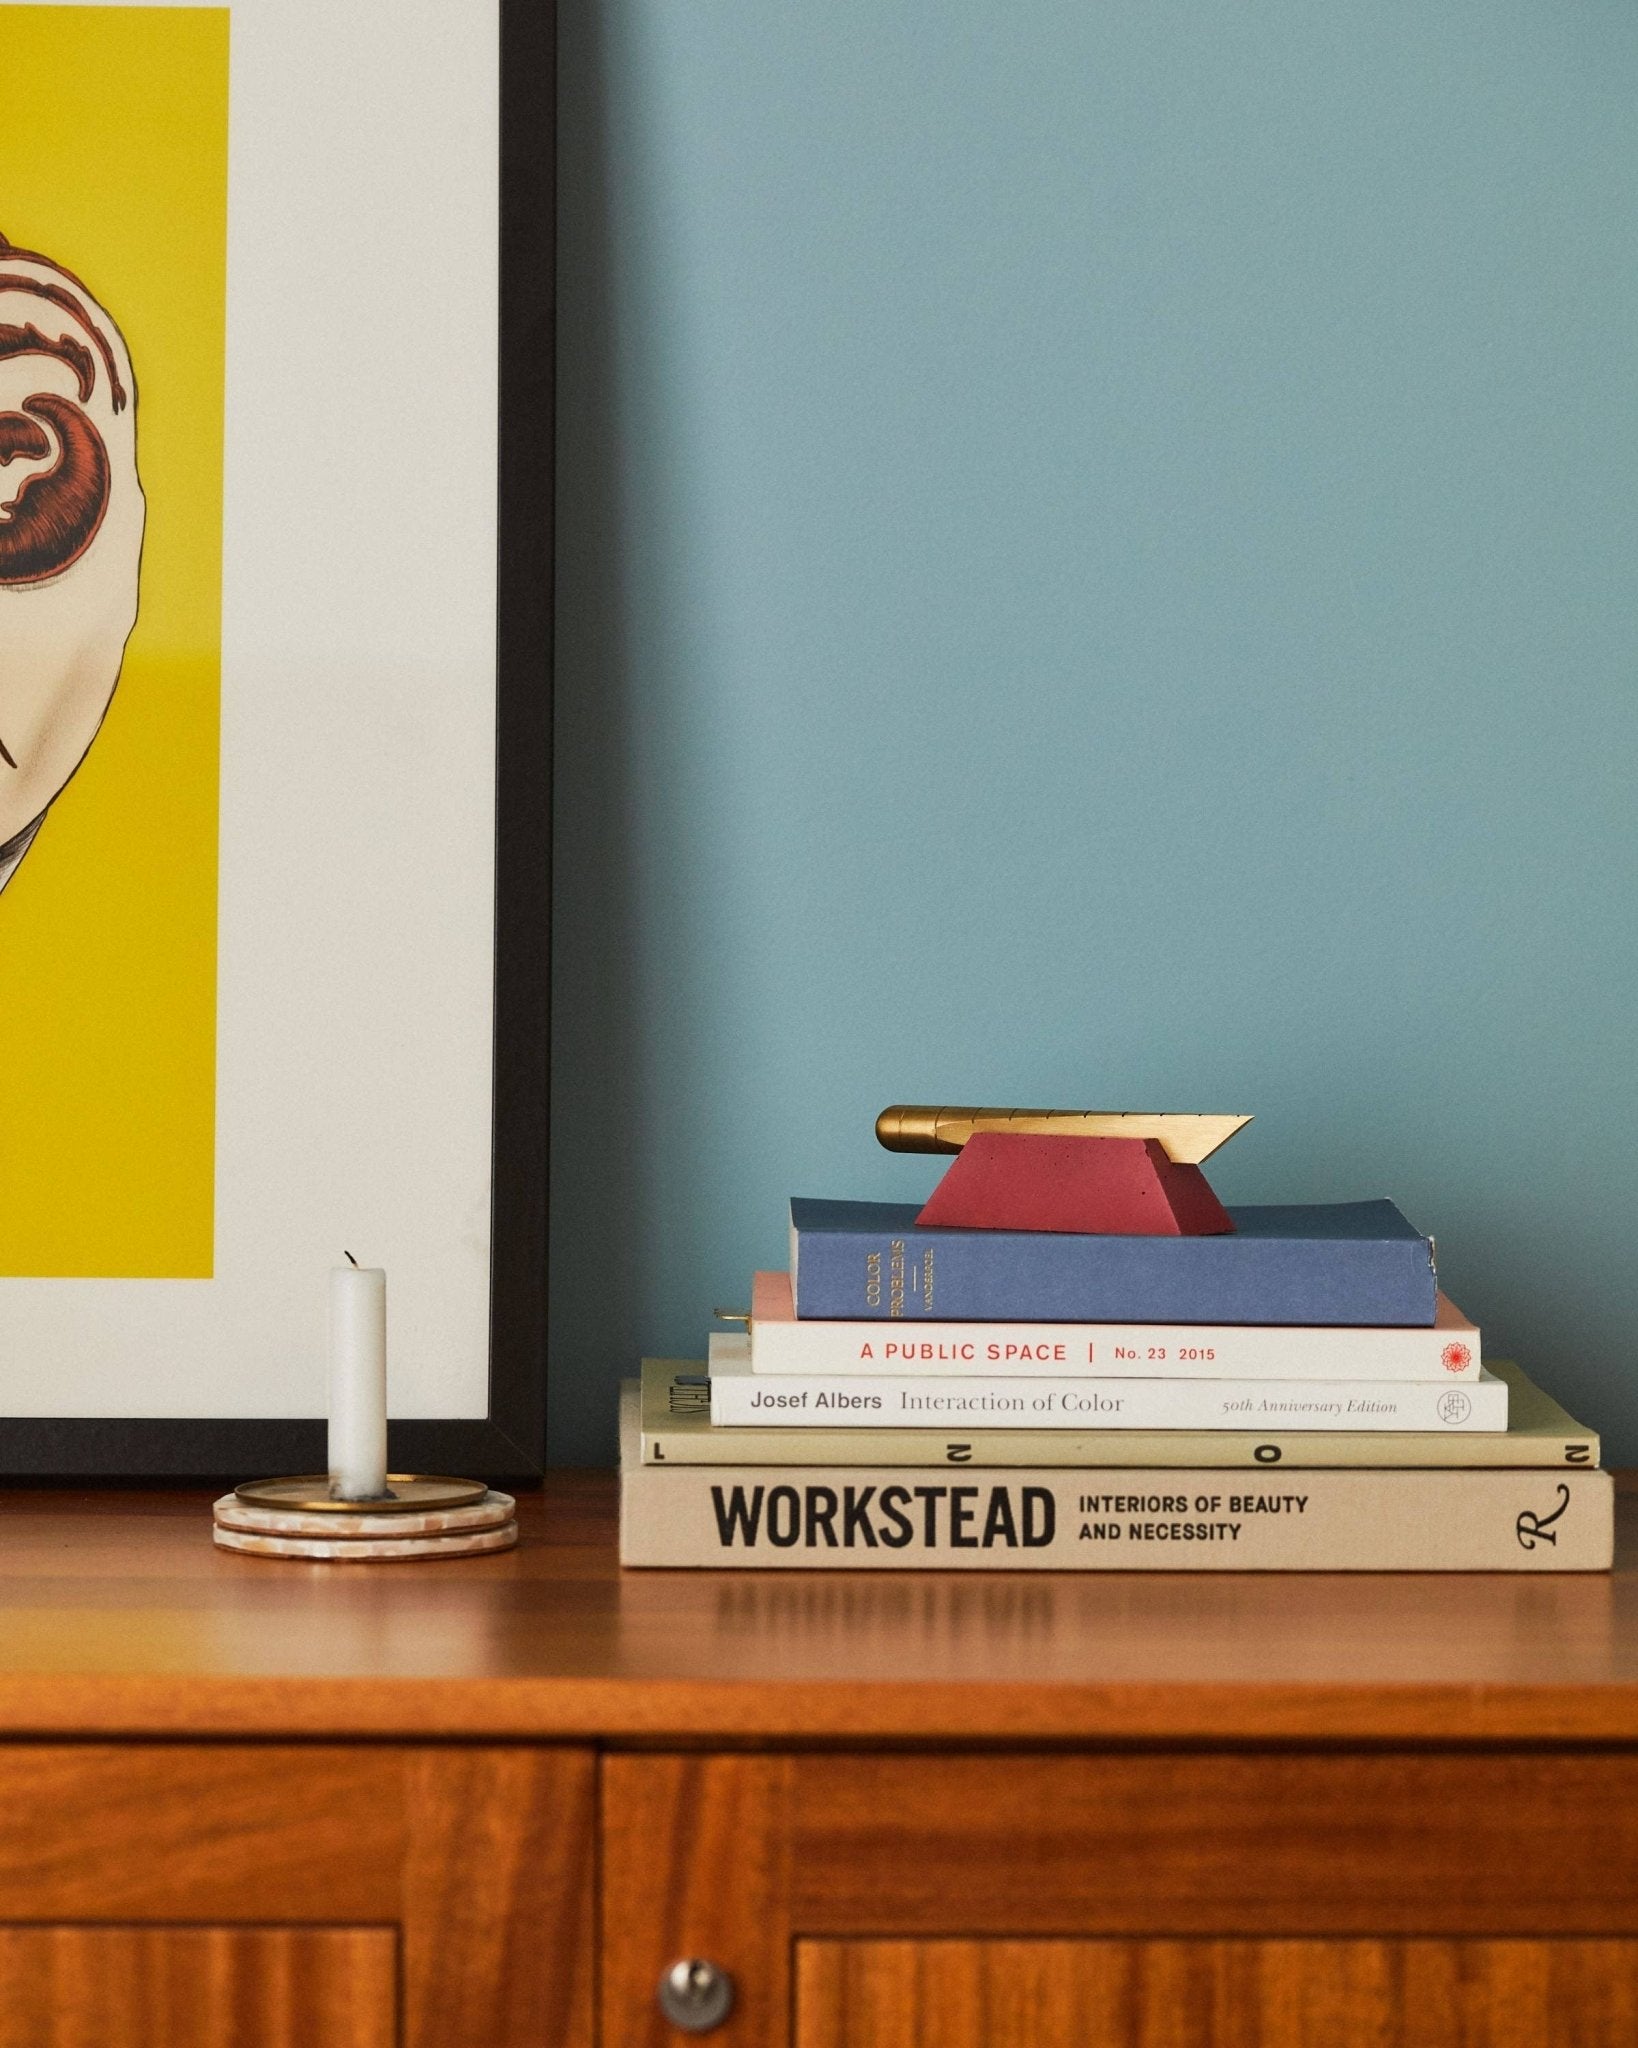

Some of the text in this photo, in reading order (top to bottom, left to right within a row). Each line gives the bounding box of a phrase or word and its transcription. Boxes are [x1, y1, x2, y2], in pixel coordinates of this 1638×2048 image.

[866, 1252, 880, 1306] COLOR
[890, 1240, 904, 1317] PROBLEMS
[860, 1343, 1066, 1361] A PUBLIC SPACE
[1115, 1347, 1216, 1360] No. 23 2015
[750, 1391, 883, 1410] Josef Albers
[901, 1391, 1125, 1412] Interaction of Color
[1223, 1398, 1397, 1417] 50th Anniversary Edition
[1079, 1496, 1309, 1514] INTERIORS OF BEAUTY
[711, 1486, 1056, 1548] WORKSTEAD
[1078, 1523, 1242, 1541] AND NECESSITY
